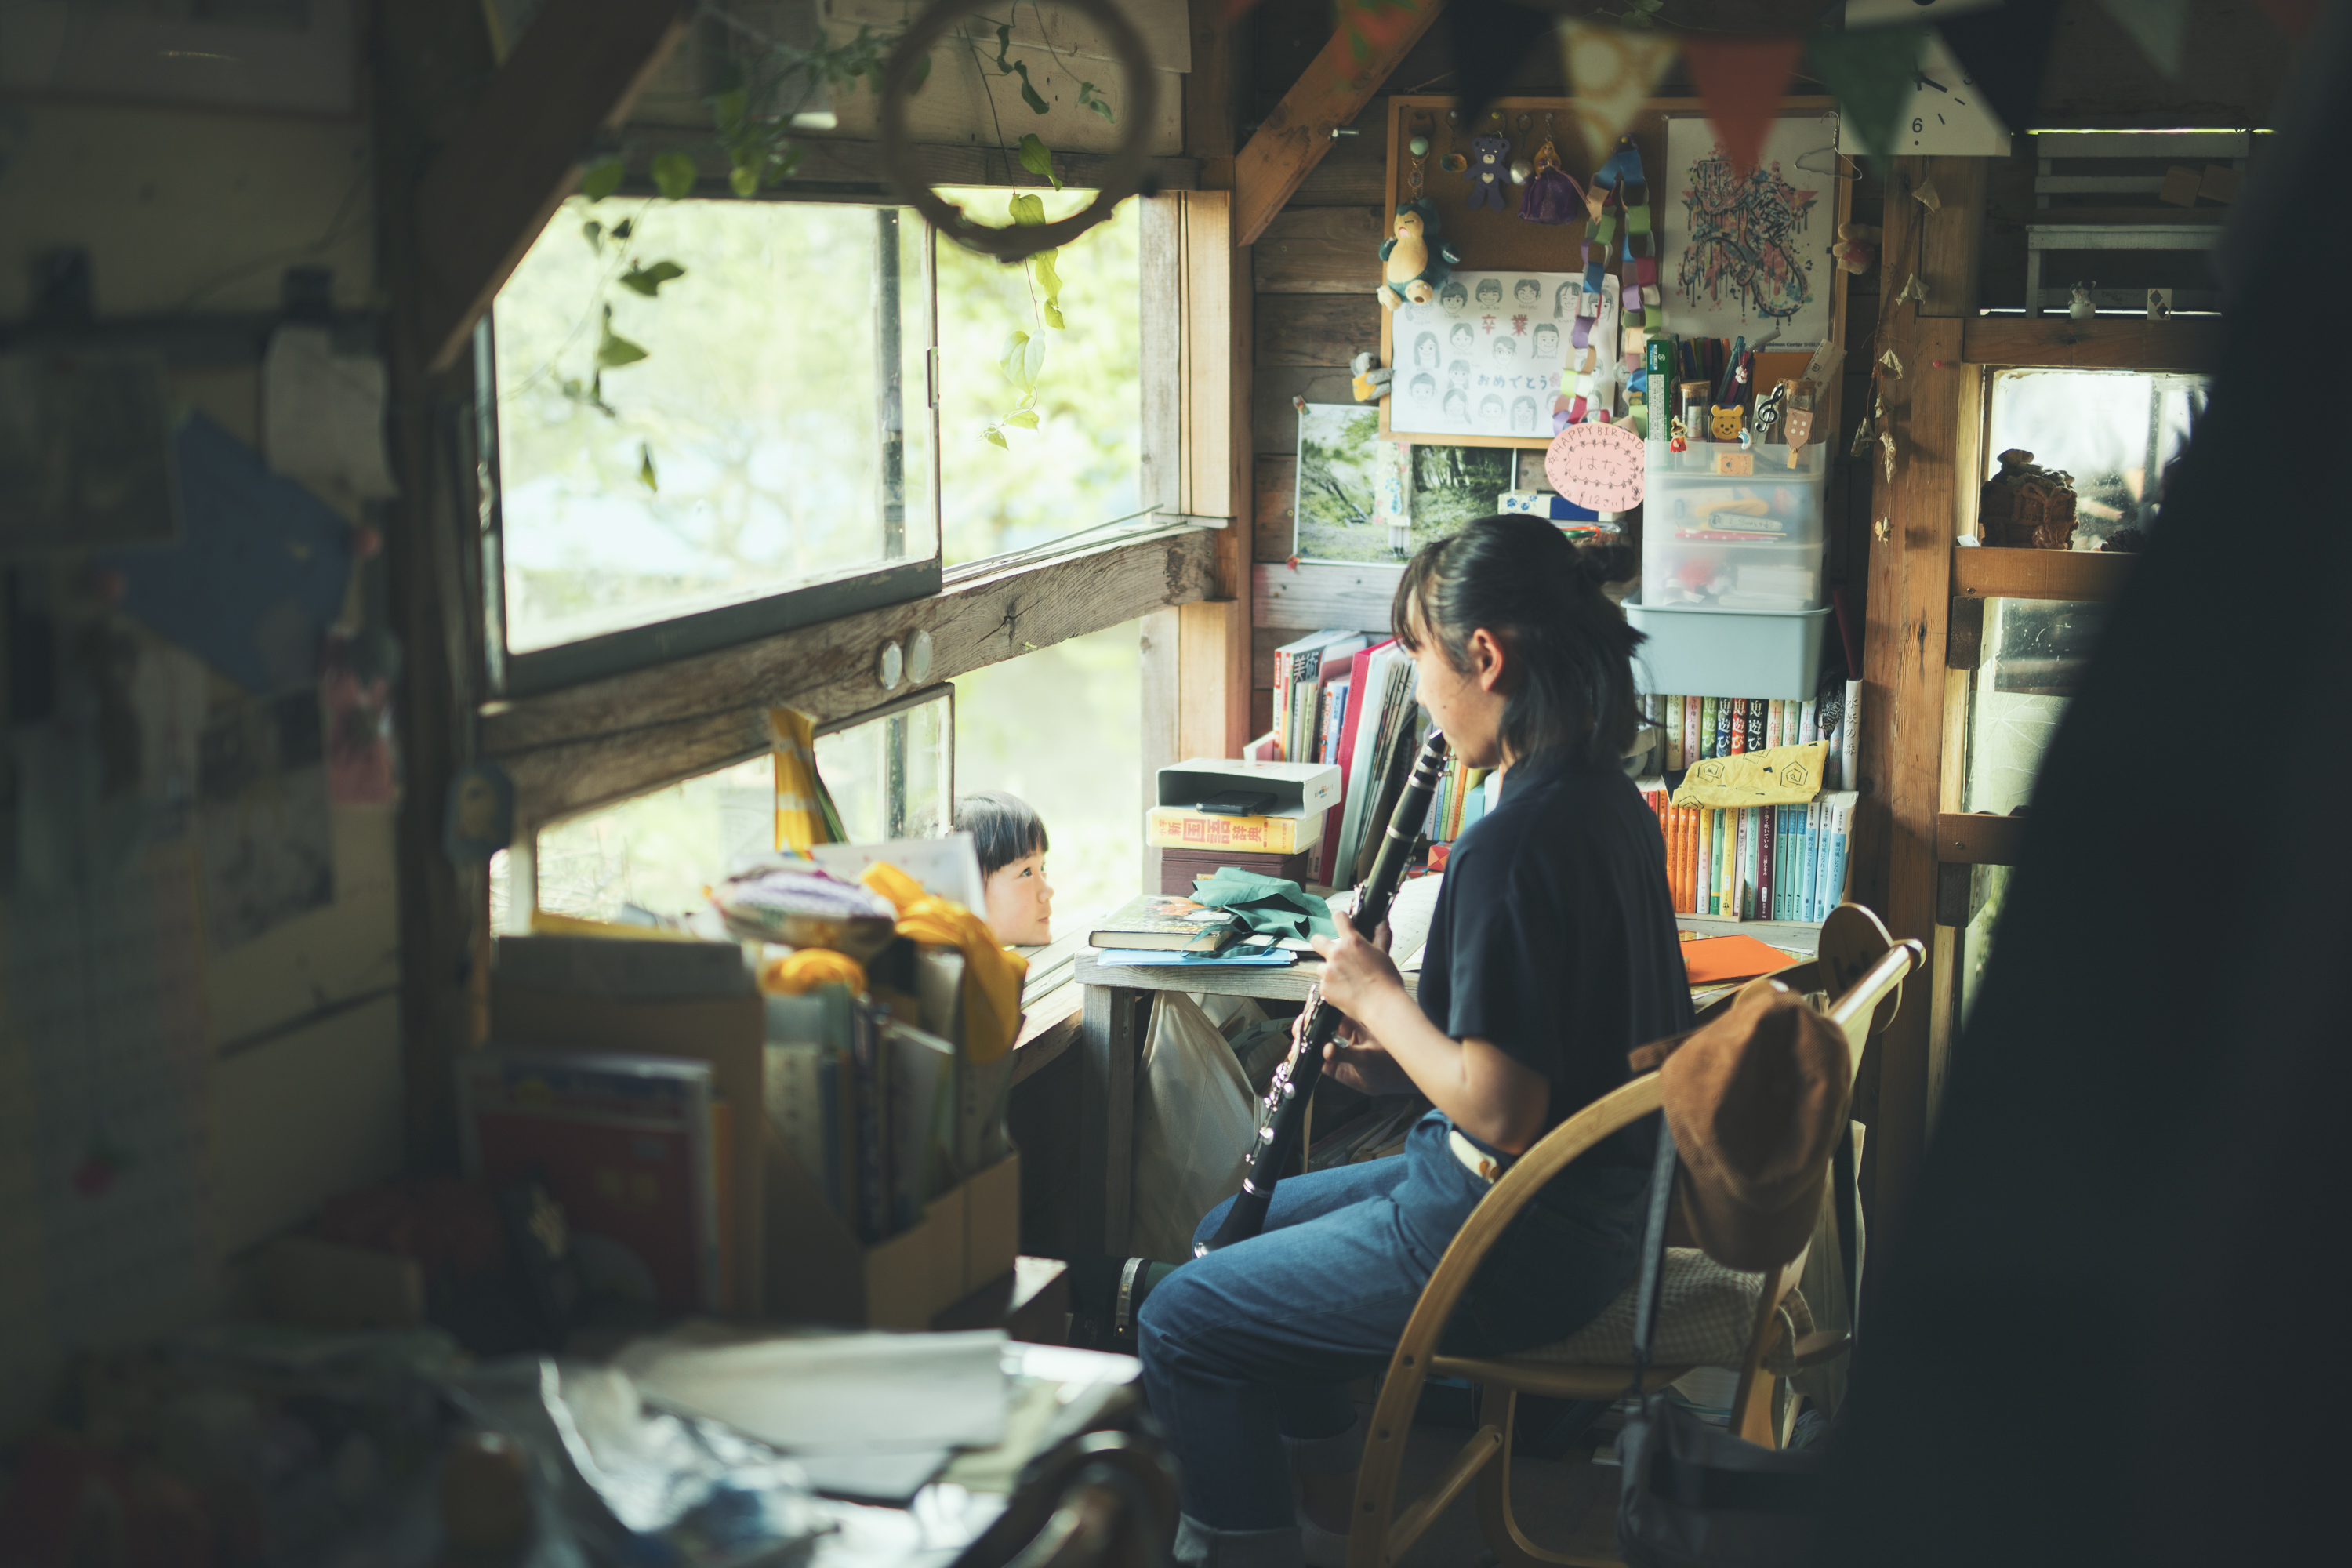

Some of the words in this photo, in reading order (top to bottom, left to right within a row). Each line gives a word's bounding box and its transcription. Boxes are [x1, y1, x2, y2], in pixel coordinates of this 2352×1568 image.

[1911, 117, 1923, 133] 6
[1482, 314, 1528, 336] 卒業
[1478, 373, 1548, 390] おめでとう
[1553, 425, 1593, 454] HAPPY
[1597, 426, 1645, 457] BIRTHD
[1579, 456, 1622, 477] はな
[1589, 495, 1617, 507] 12さい
[1293, 652, 1319, 684] 美術
[1703, 697, 1717, 748] 鬼遊び
[1717, 698, 1732, 749] 鬼遊び
[1731, 699, 1746, 749] 鬼遊び
[1748, 699, 1763, 750] 鬼遊び
[1843, 696, 1858, 756] 水妖の森
[1168, 817, 1263, 845] 新国語辞典
